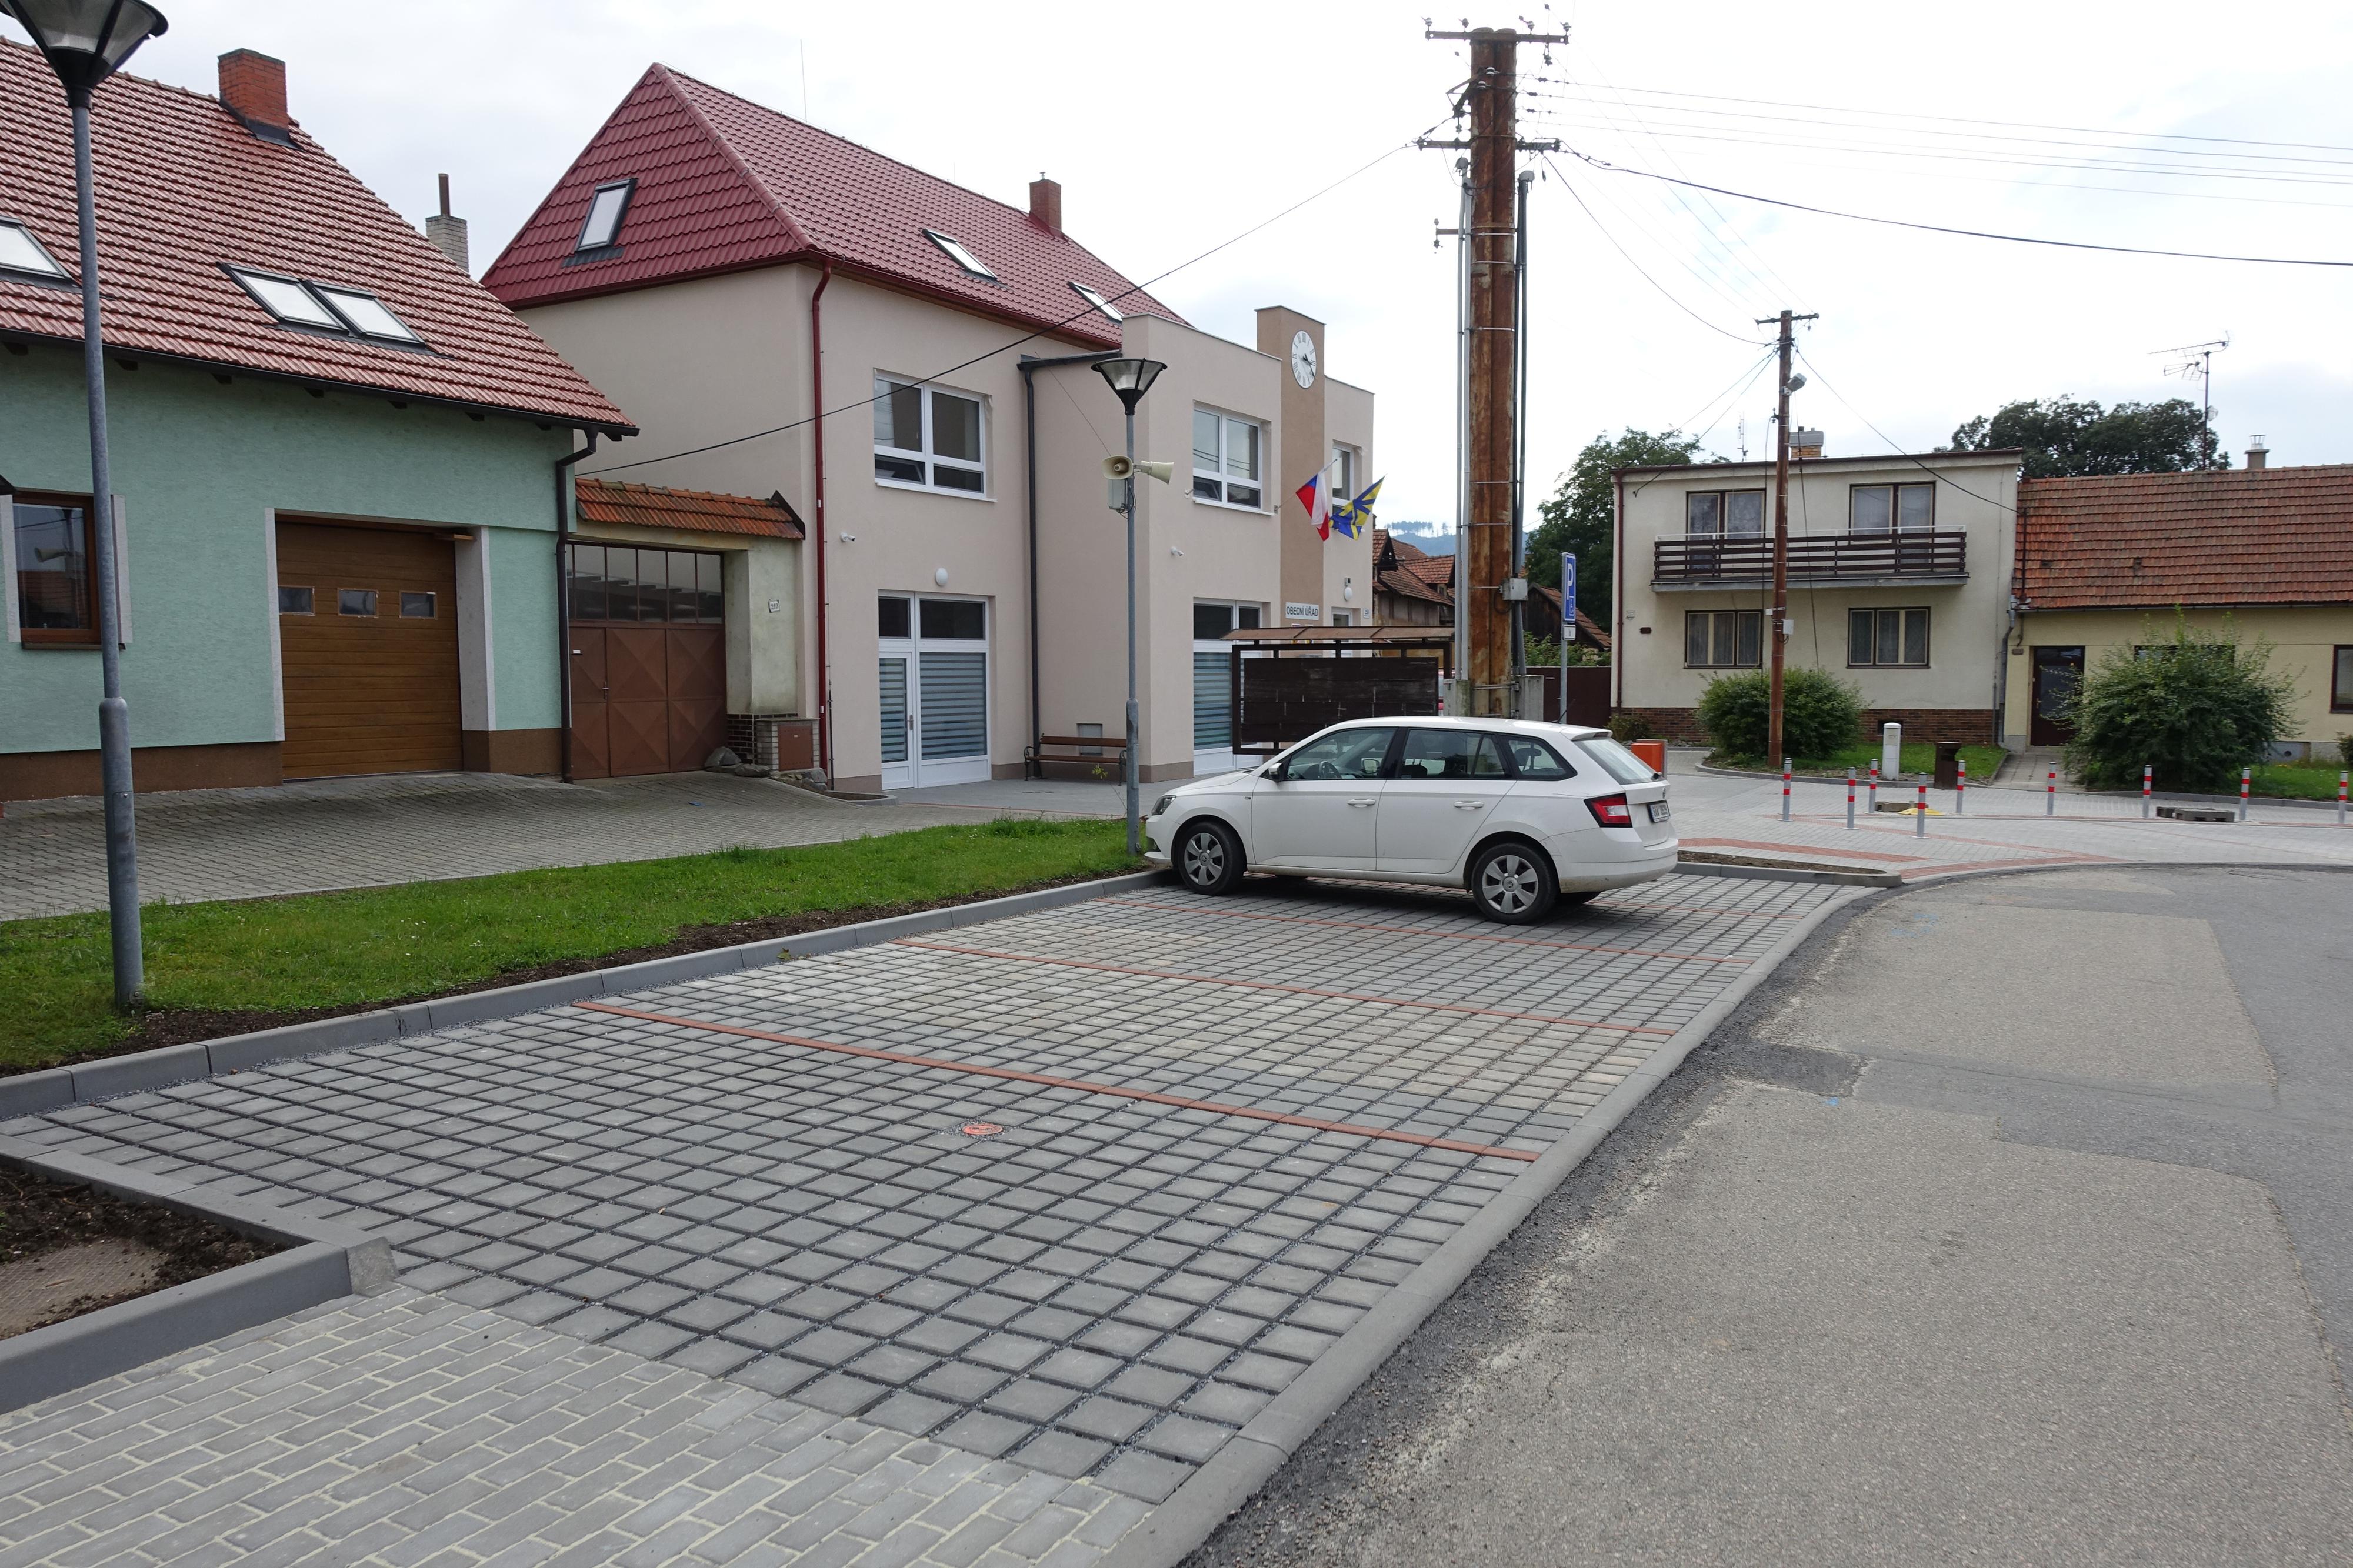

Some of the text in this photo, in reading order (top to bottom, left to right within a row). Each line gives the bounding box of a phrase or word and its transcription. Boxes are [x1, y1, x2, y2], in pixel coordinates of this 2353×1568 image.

[1567, 563, 1573, 600] P
[1287, 606, 1318, 616] OBECNÍ ÚŘAD
